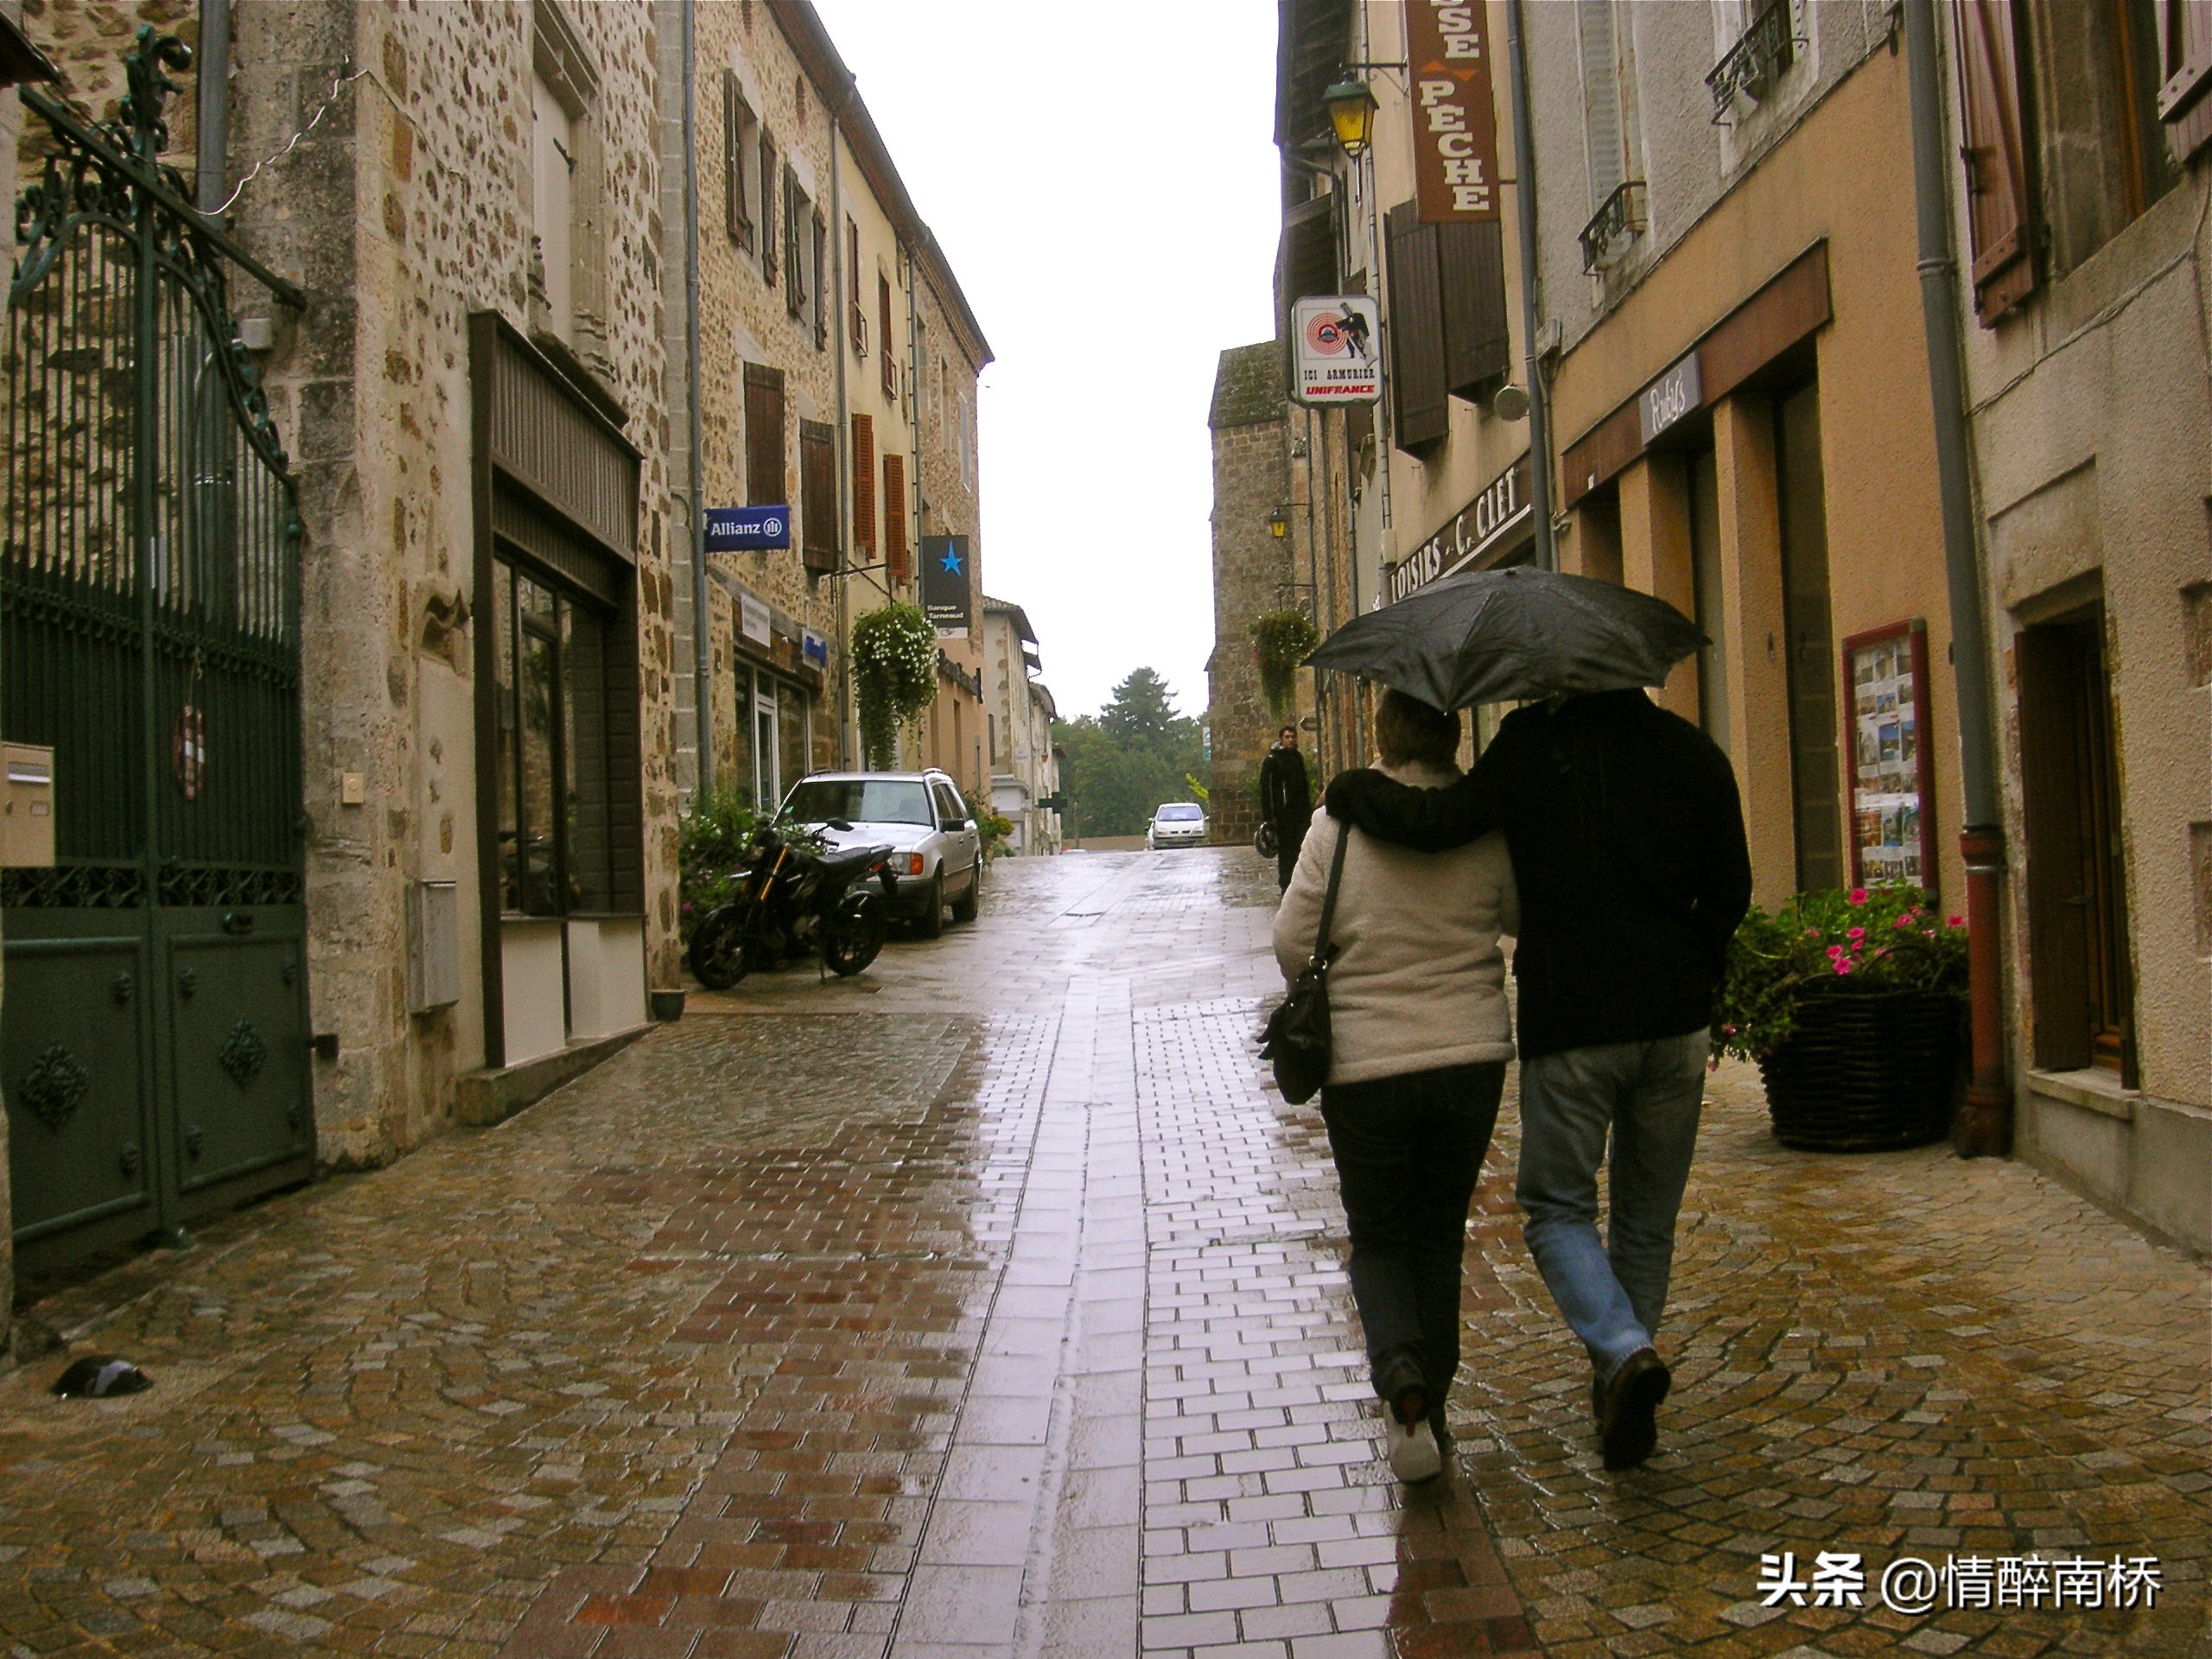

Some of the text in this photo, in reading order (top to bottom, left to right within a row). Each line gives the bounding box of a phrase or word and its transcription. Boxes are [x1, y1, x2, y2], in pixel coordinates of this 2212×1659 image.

[1419, 0, 1489, 211] SE PÊCHE
[1304, 368, 1375, 380] ICI ARMURIER
[1306, 385, 1375, 395] UNIFRANCE
[710, 522, 760, 536] Allianz
[1391, 537, 1441, 603] LOISIRS
[1476, 467, 1516, 538] CLET
